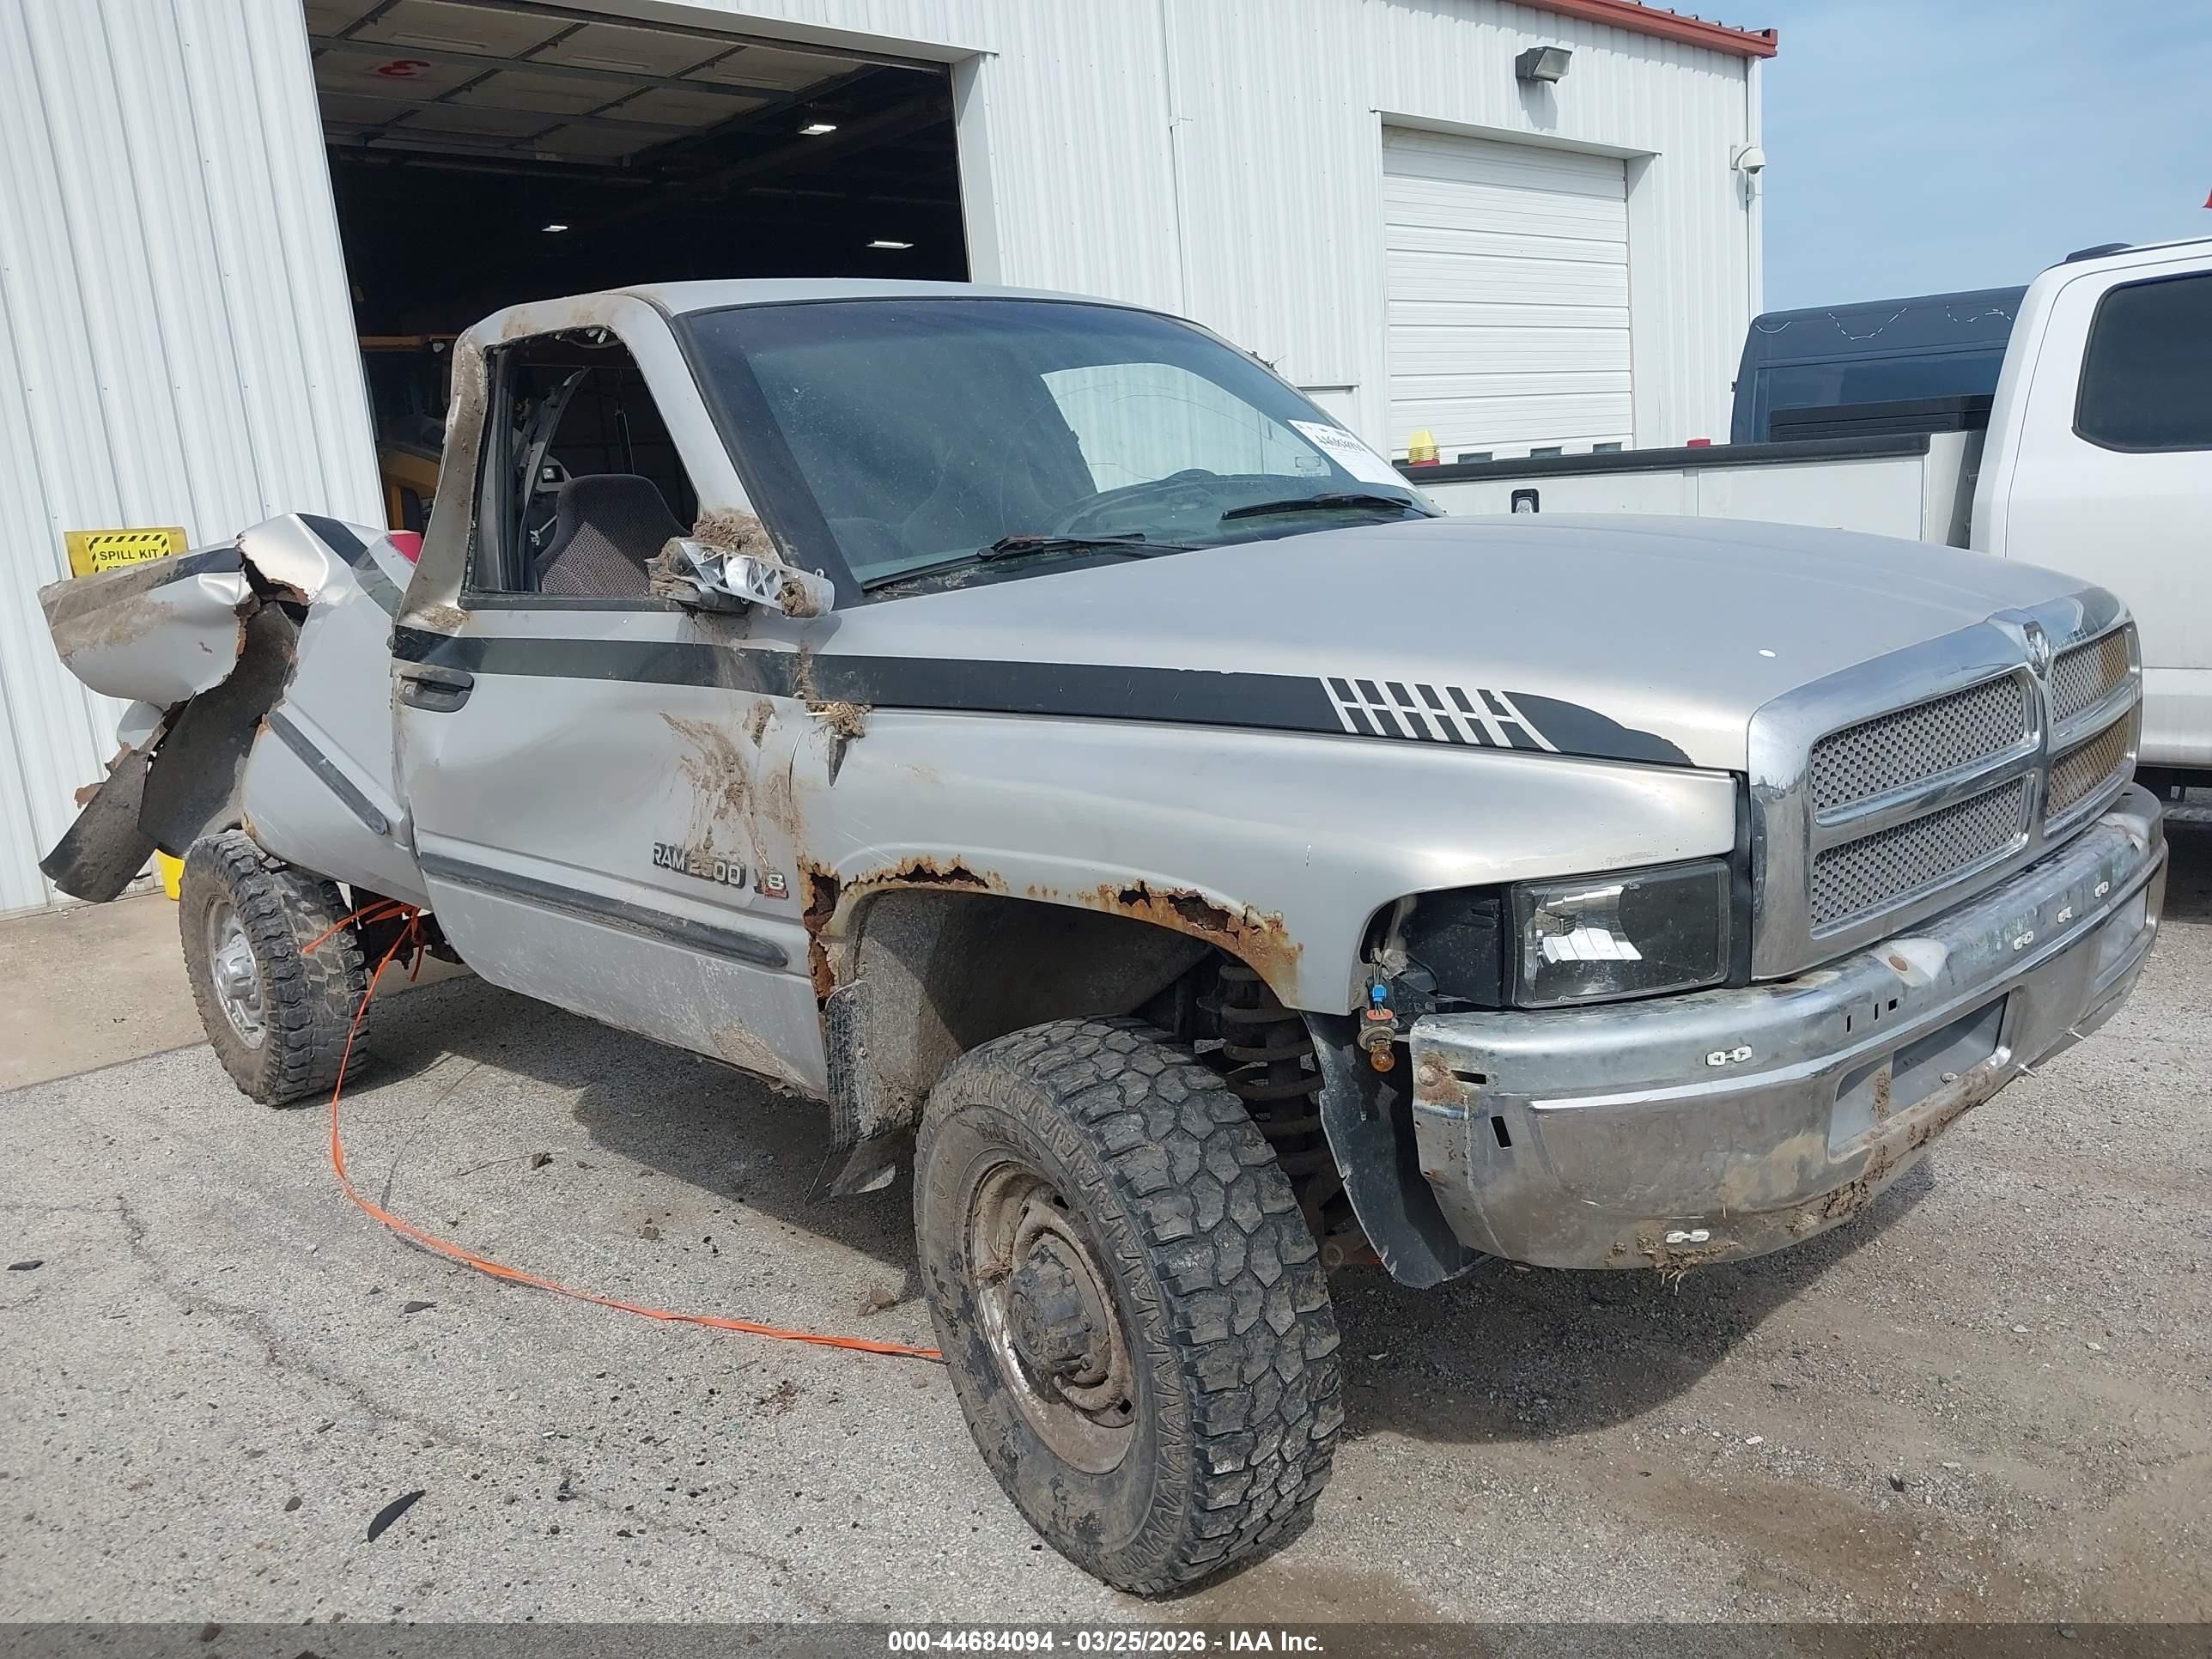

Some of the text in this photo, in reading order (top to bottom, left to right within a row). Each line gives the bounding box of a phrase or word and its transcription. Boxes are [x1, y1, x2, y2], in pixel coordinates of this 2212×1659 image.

[100, 549, 159, 561] SPILL KIT
[653, 842, 686, 871] RAM
